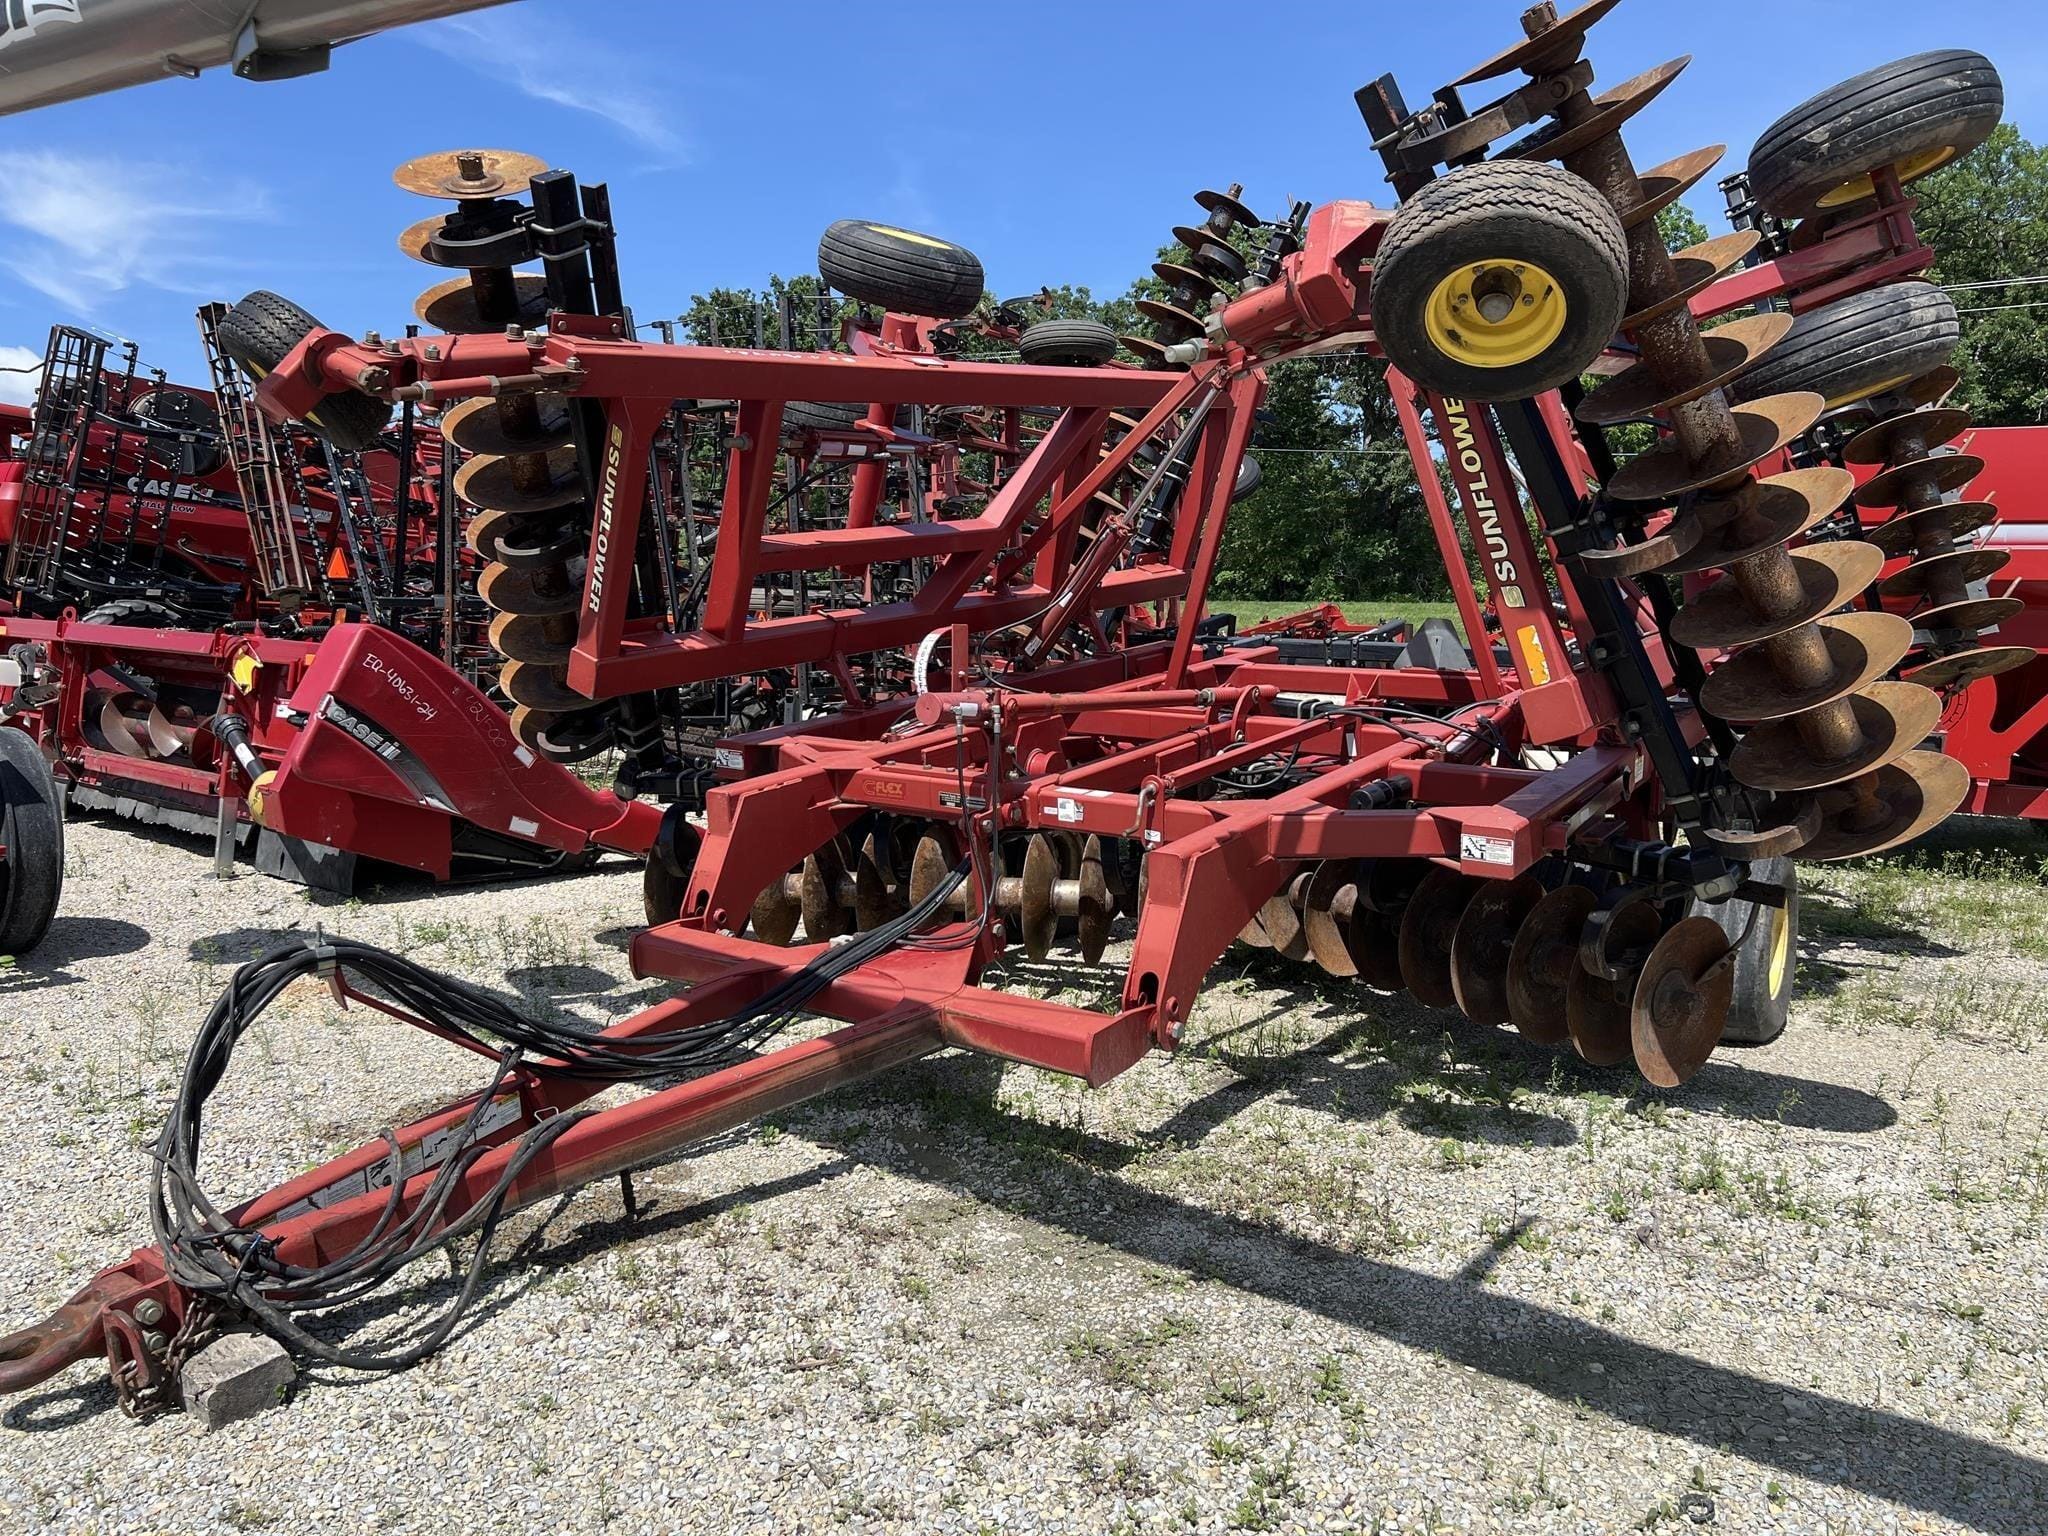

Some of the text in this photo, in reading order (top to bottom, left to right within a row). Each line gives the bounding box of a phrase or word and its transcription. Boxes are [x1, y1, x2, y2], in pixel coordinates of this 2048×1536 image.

[589, 446, 620, 613] SUNFLOWER
[1443, 397, 1517, 583] SUNFLOWE
[332, 706, 384, 748] CASE
